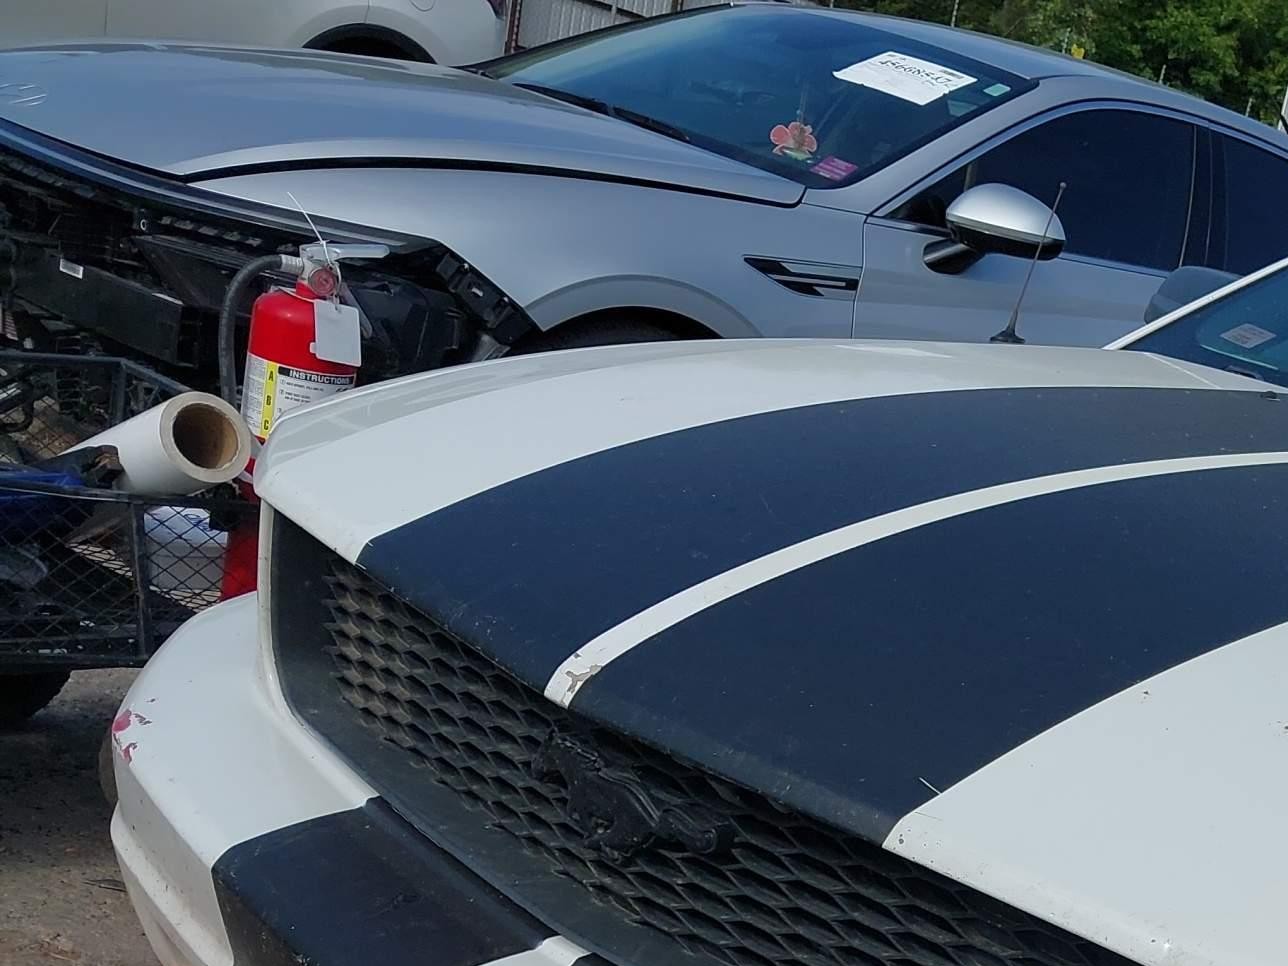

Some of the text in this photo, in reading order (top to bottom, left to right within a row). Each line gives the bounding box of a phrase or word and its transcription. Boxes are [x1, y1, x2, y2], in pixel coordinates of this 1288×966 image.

[268, 371, 274, 382] A
[289, 369, 350, 385] INSTRUCTIONS
[266, 395, 271, 406] B
[263, 420, 269, 431] C
